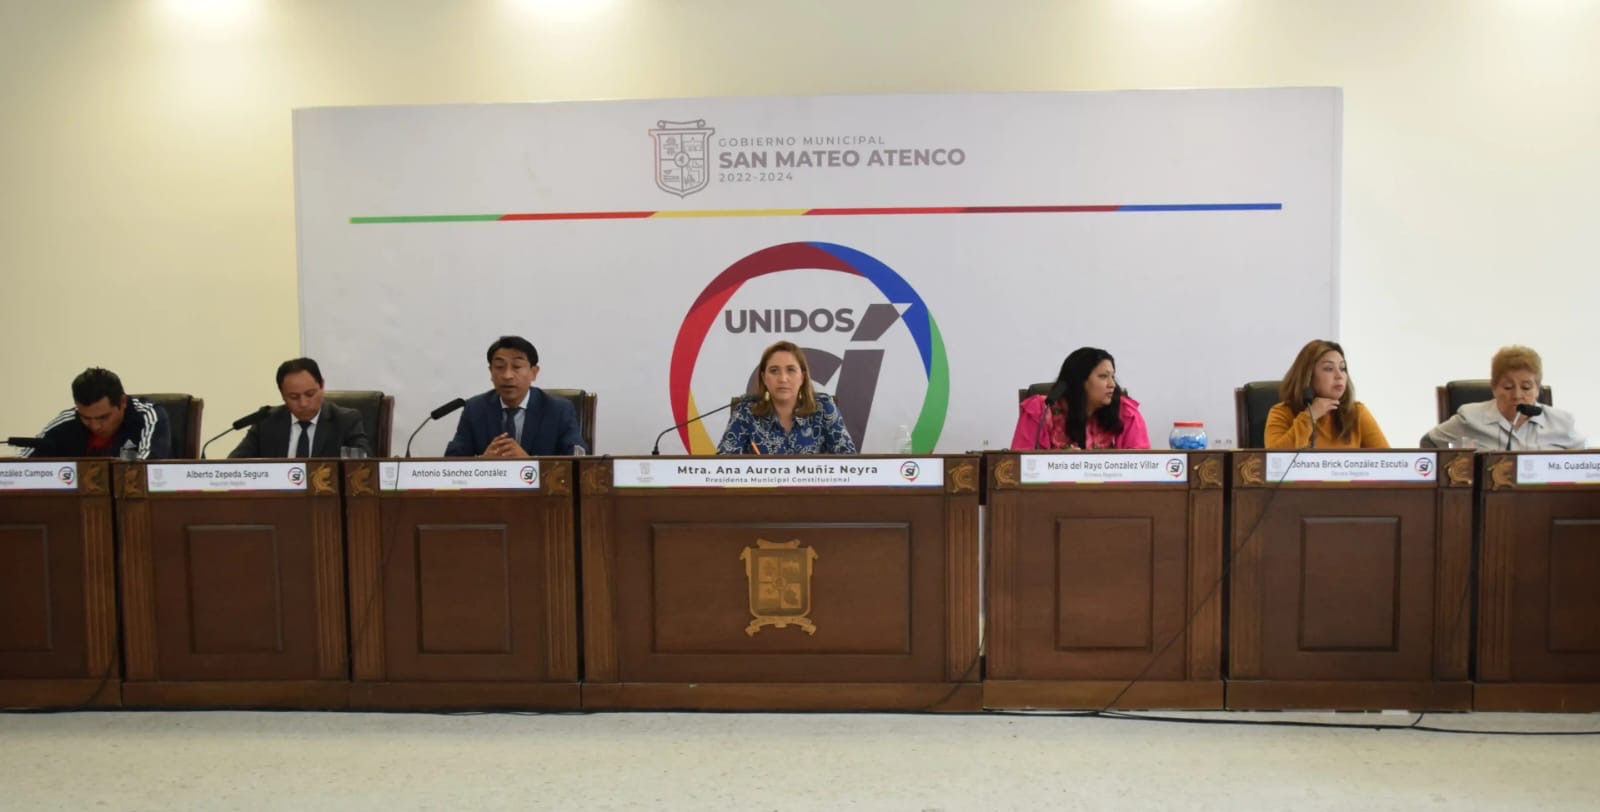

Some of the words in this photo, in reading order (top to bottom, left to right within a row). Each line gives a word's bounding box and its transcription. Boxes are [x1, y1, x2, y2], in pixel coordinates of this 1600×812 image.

[718, 137, 797, 148] GOBIERNO
[802, 135, 886, 146] MUNICIPAL
[718, 151, 768, 169] SAN
[775, 150, 861, 168] MATEO
[867, 148, 967, 167] ATENCO
[718, 172, 794, 183] 2022-2024
[724, 307, 855, 334] UNIDOS
[1070, 461, 1082, 470] del
[1084, 461, 1102, 472] Rayo
[1139, 460, 1160, 470] Villar
[1322, 459, 1341, 469] Brick
[24, 469, 54, 478] Campos
[186, 470, 214, 479] Alberto
[214, 470, 242, 480] Zepeda
[243, 470, 269, 480] Segura
[411, 469, 441, 478] Antonio
[441, 468, 473, 478] Sánchez
[474, 468, 508, 478] González
[677, 465, 711, 475] Mtra.
[716, 465, 741, 475] Ana
[746, 465, 791, 475] Aurora
[796, 464, 835, 474] Muñiz
[840, 464, 878, 476] Neyra
[751, 476, 789, 484] Municipal
[792, 476, 850, 484] Constitucional
